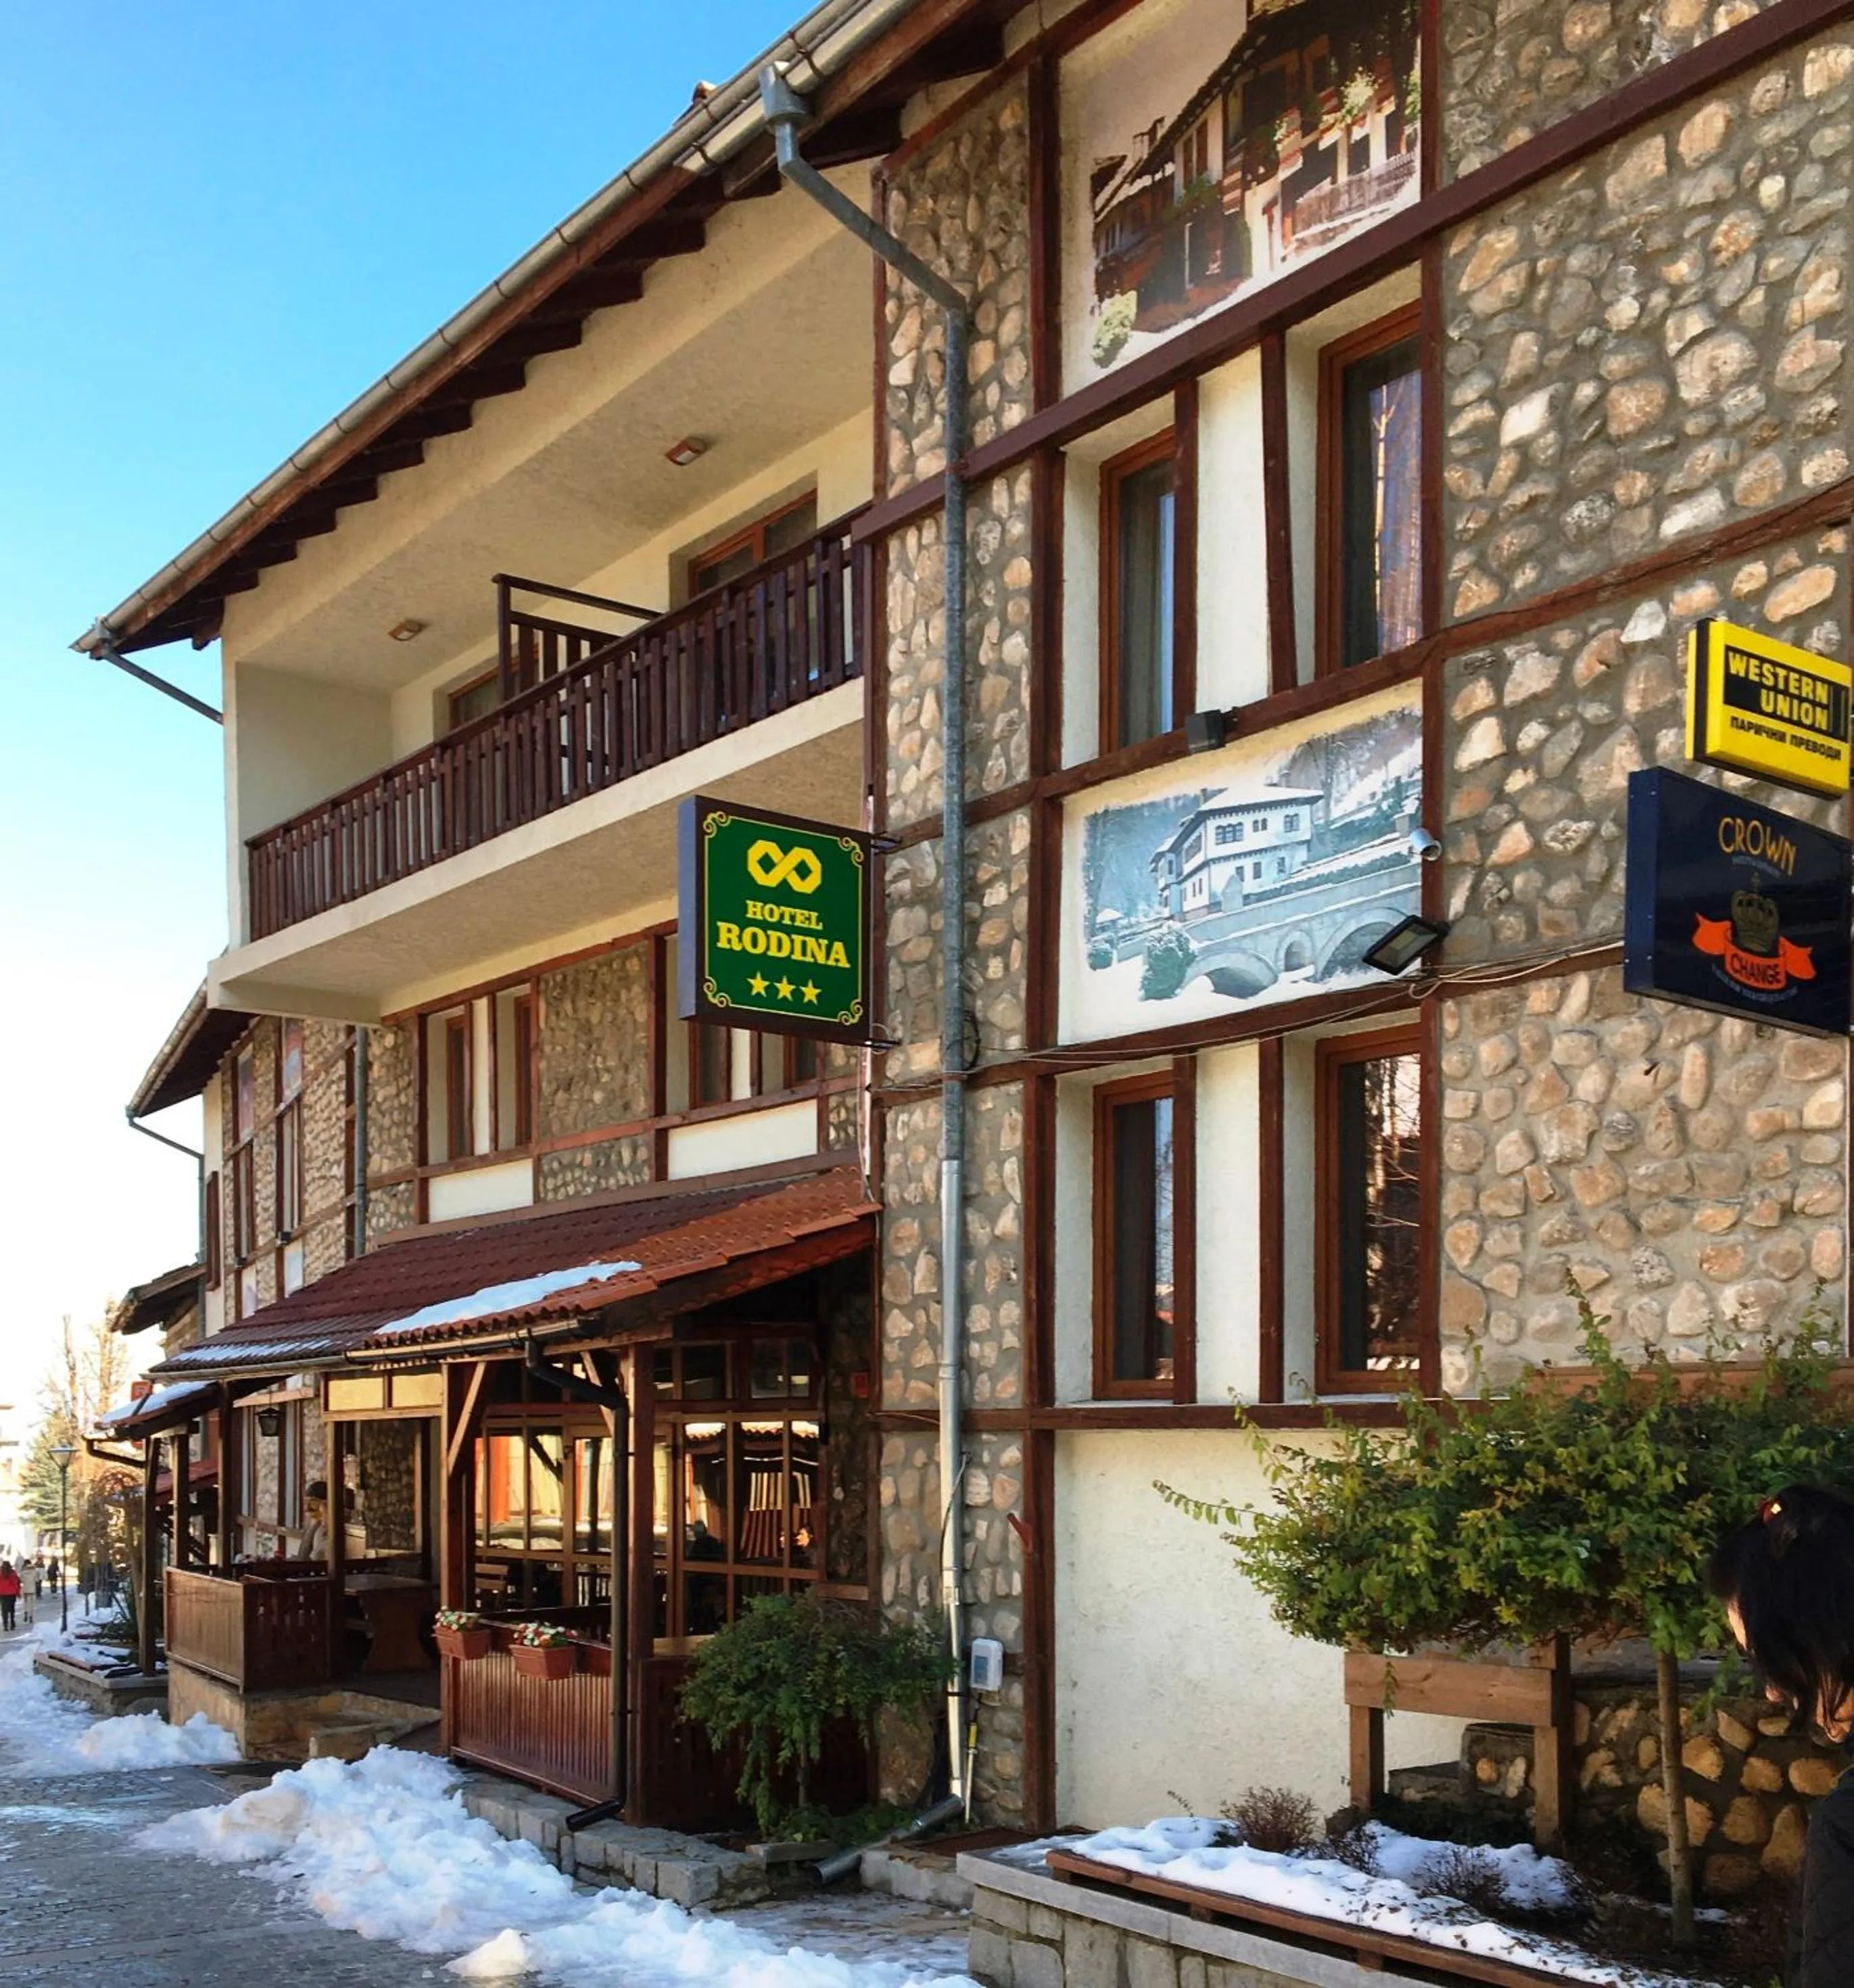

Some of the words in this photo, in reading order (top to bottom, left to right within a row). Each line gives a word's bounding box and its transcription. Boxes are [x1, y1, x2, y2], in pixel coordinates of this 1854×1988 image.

[1728, 650, 1828, 705] WESTERN
[1761, 688, 1828, 730] UNION
[1730, 715, 1786, 744] ПАРИЧНИ
[1790, 734, 1842, 761] ПРЕВОДИ
[1718, 816, 1797, 876] CROWN
[745, 899, 822, 930] HOTEL
[717, 921, 851, 968] RODINA
[1730, 953, 1782, 985] CHANGE
